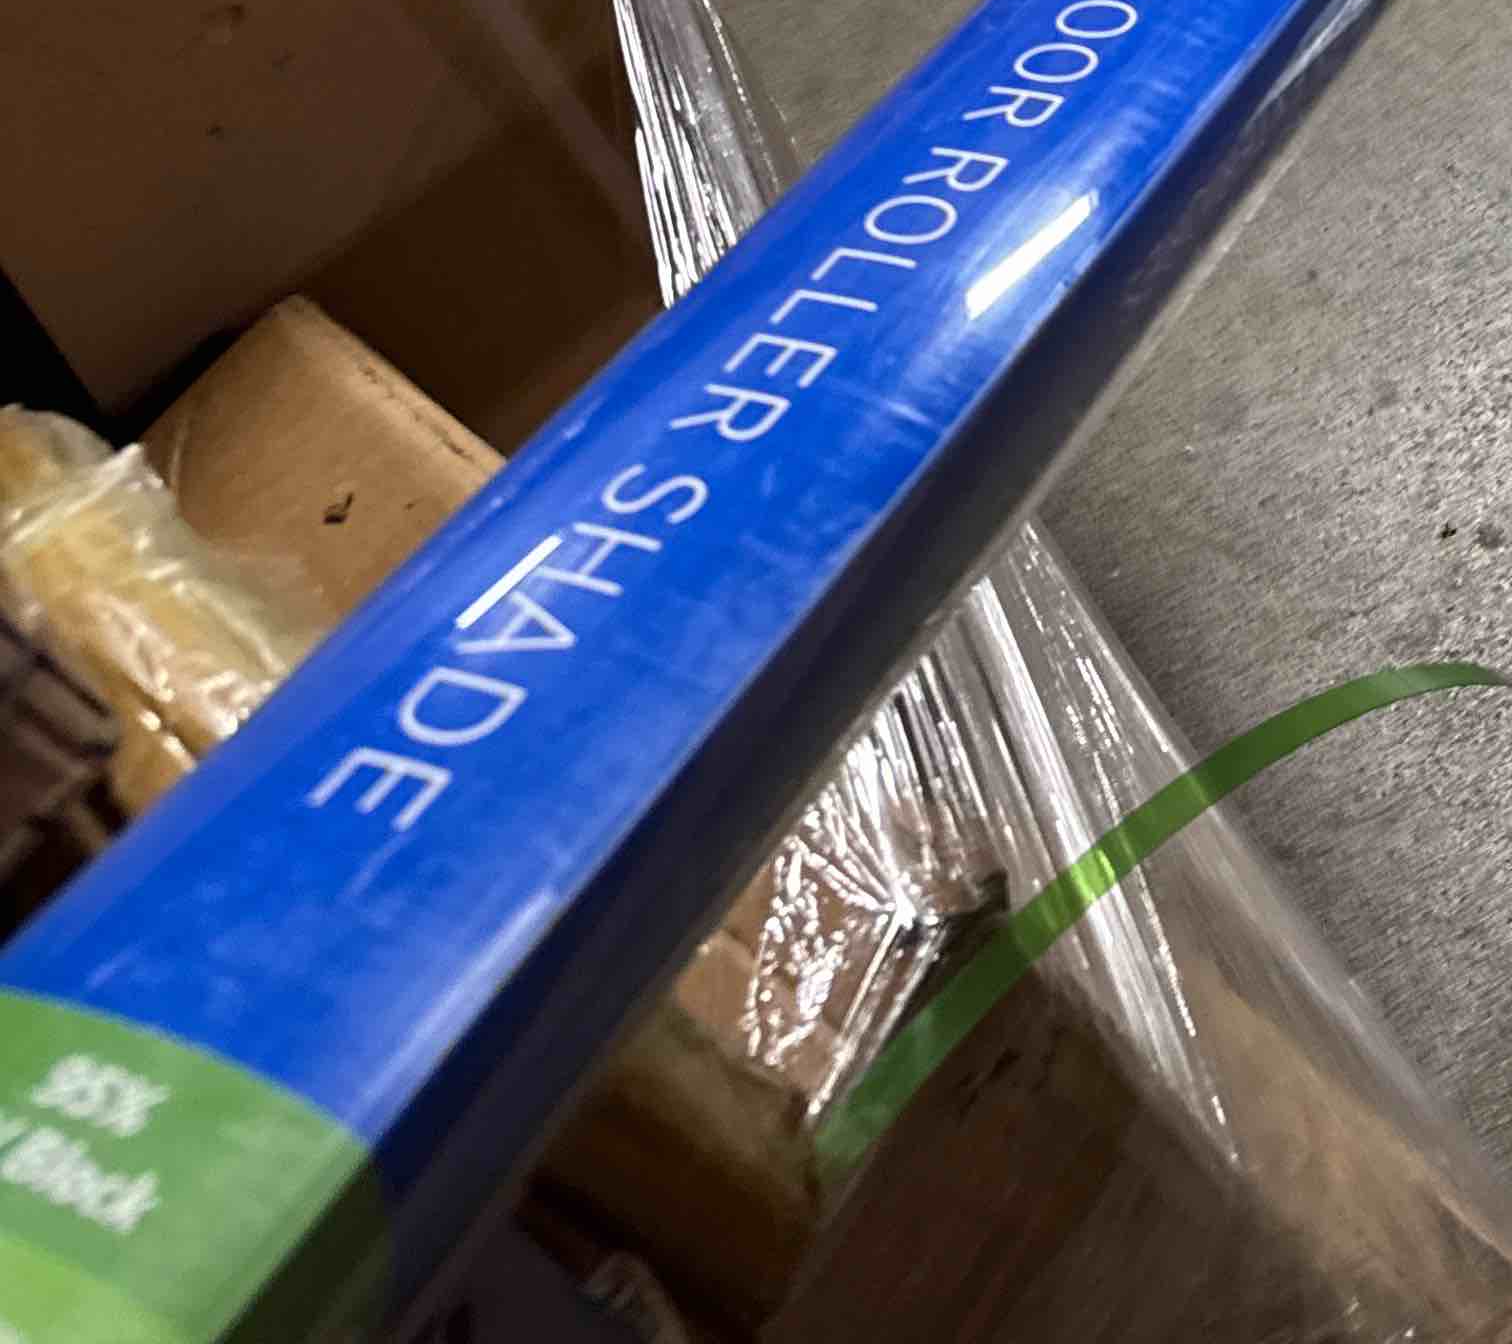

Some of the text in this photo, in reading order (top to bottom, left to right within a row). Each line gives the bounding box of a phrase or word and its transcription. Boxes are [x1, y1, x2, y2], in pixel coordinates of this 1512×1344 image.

[670, 146, 1009, 442] ROLLER
[308, 462, 707, 832] SHADE
[1, 1125, 160, 1233] Block
